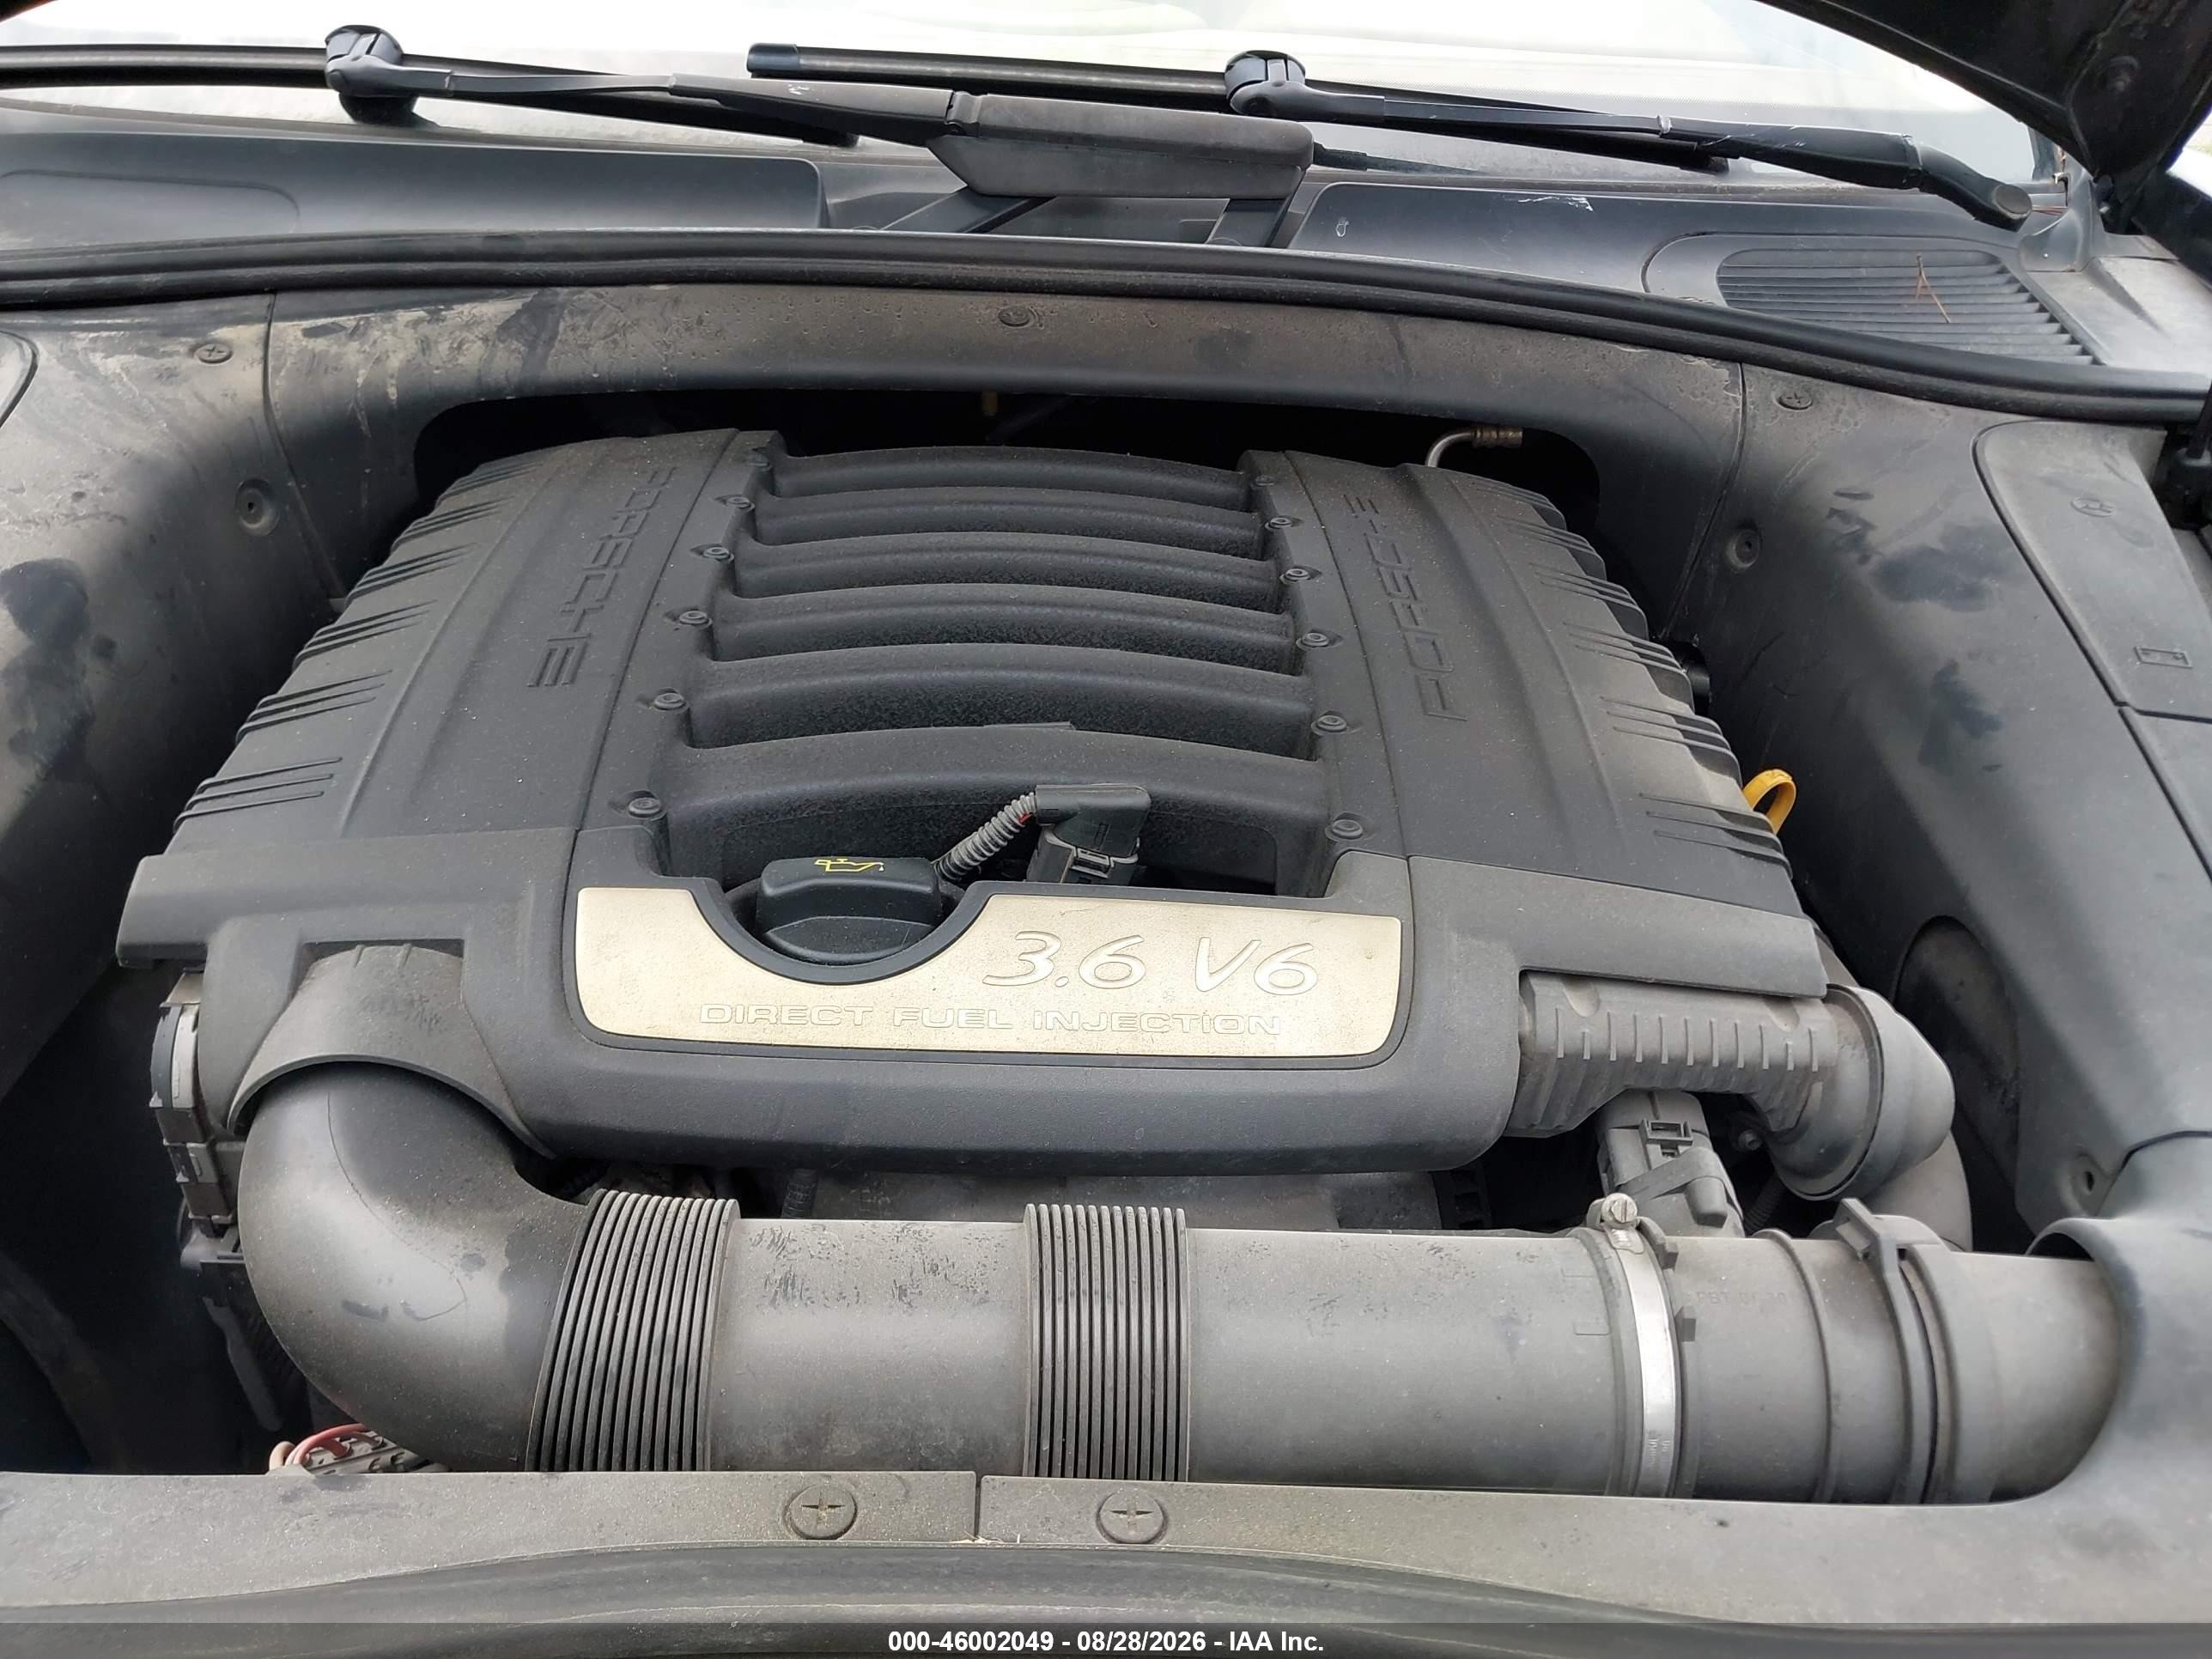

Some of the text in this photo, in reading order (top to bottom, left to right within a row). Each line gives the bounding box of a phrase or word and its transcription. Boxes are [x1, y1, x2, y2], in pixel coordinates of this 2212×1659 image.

[1343, 493, 1471, 722] PORSCHE
[981, 930, 1319, 996] 3.6 V6
[700, 1003, 1281, 1036] DIRECT FUEL INJECTION
